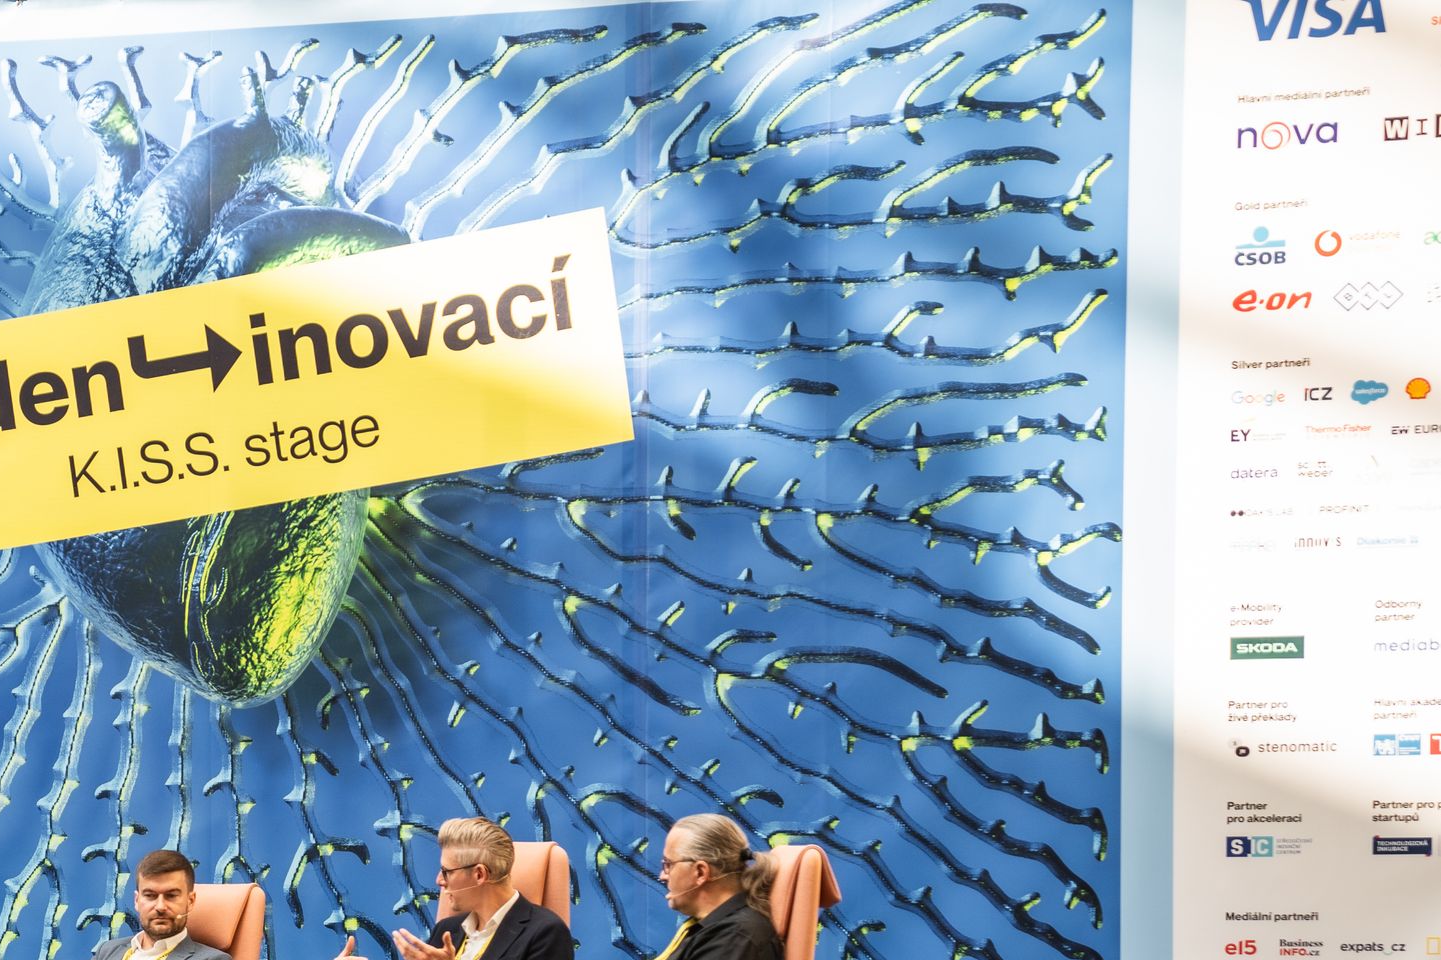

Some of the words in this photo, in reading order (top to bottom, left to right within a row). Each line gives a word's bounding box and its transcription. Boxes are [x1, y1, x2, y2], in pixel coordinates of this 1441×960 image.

[1240, 0, 1387, 41] VISA
[1237, 121, 1338, 150] nova
[250, 253, 574, 386] inovací
[1231, 361, 1263, 369] Silver
[1265, 358, 1310, 369] partneři
[1231, 390, 1286, 406] Google
[1414, 424, 1441, 434] EUR
[1231, 429, 1251, 442] EY
[68, 431, 228, 498] K.I.S.S.
[245, 415, 381, 468] stage
[1227, 700, 1267, 709] Partner
[1258, 740, 1337, 753] stenomatic
[1227, 801, 1268, 810] Partner
[1372, 800, 1414, 809] Partner
[1416, 801, 1435, 811] pro
[1227, 815, 1245, 824] pro
[1247, 813, 1302, 823] akceleraci
[1225, 912, 1272, 921] Mediální
[1274, 912, 1319, 922] partneři
